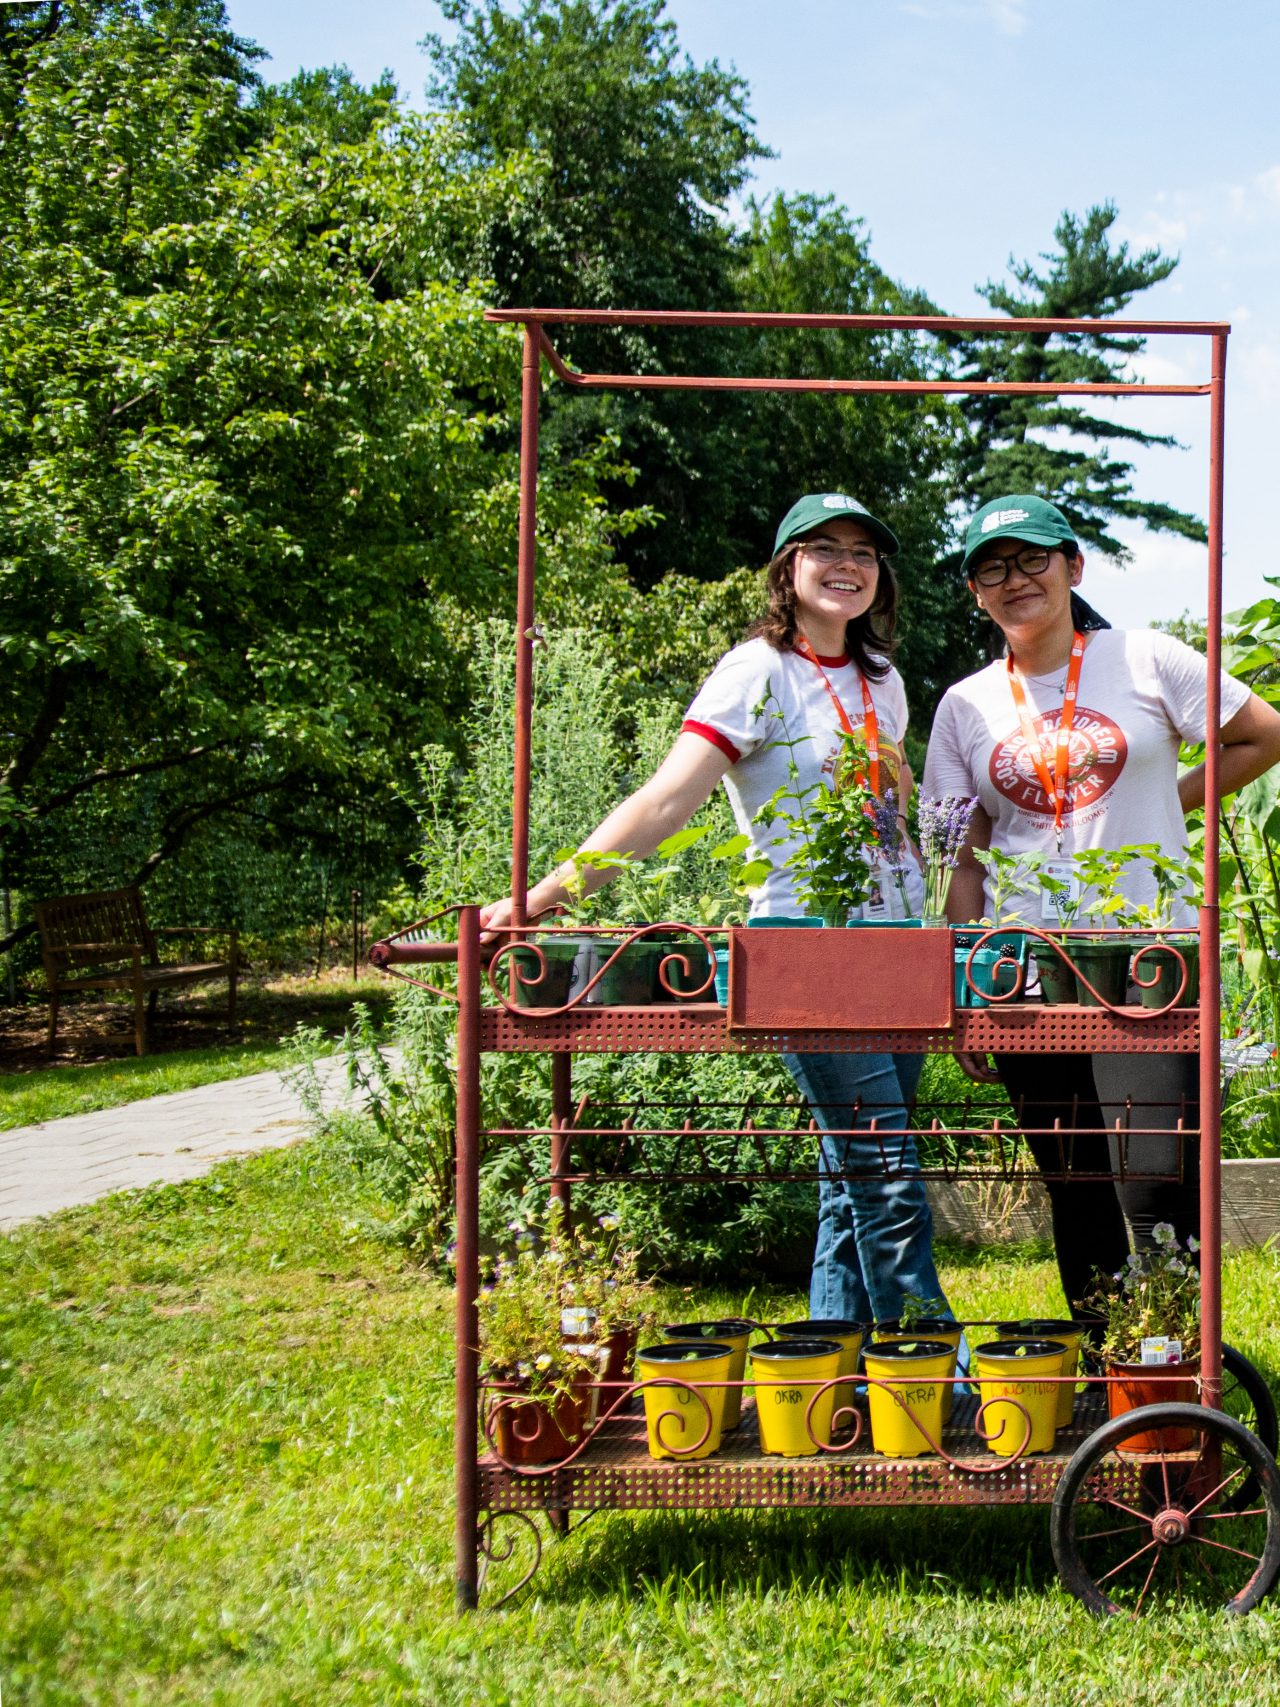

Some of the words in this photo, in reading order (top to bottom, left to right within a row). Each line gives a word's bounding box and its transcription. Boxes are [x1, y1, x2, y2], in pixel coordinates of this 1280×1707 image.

[1020, 774, 1105, 806] FLWER
[774, 1389, 803, 1405] OKRA
[893, 1386, 936, 1408] OKRA
